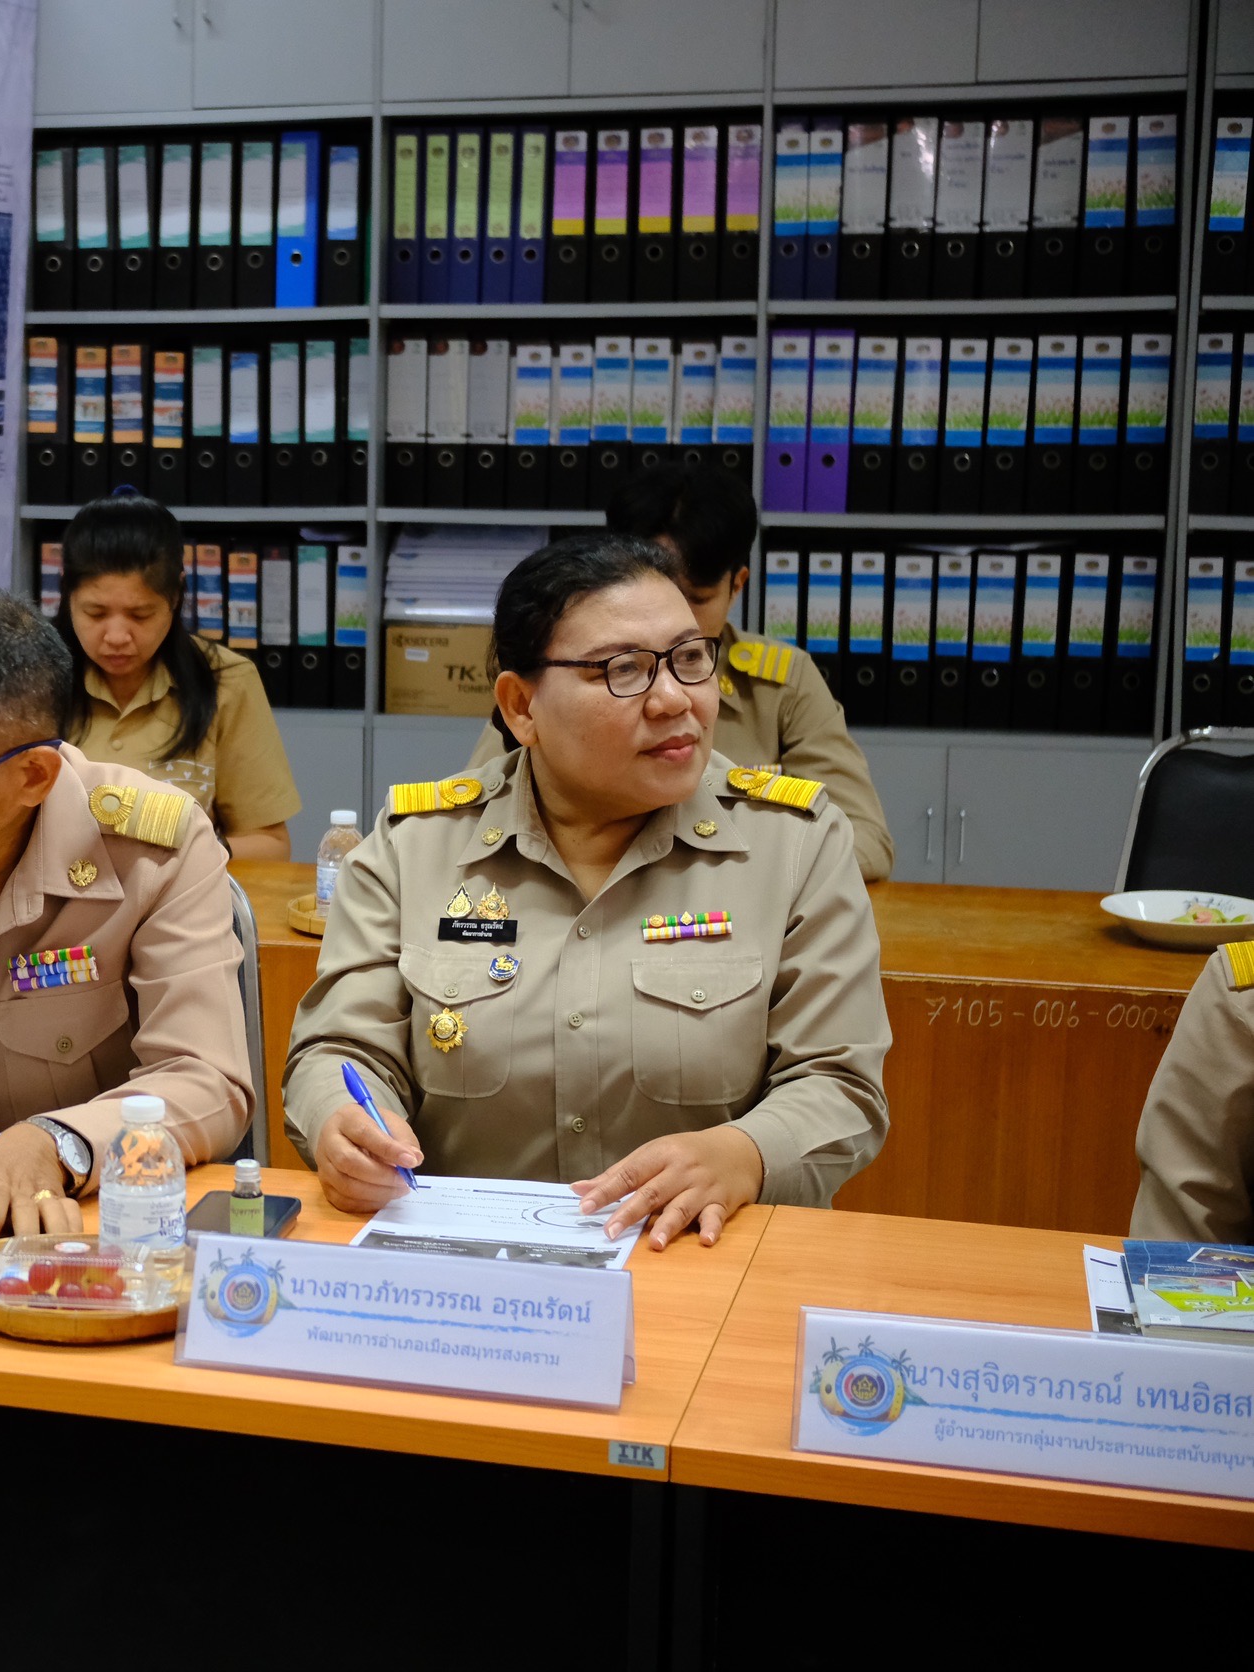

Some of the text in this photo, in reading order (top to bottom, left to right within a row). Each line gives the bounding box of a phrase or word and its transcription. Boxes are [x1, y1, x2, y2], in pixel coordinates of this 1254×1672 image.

[290, 1274, 592, 1325] นางสาวภัทรวรรณ อรุณรัตน์
[306, 1325, 561, 1367] พัฒนาการอำเภอเมืองสมุทรสงคราม
[908, 1360, 1123, 1406] นางสุจิตราภรณ์
[618, 1444, 654, 1461] ITK
